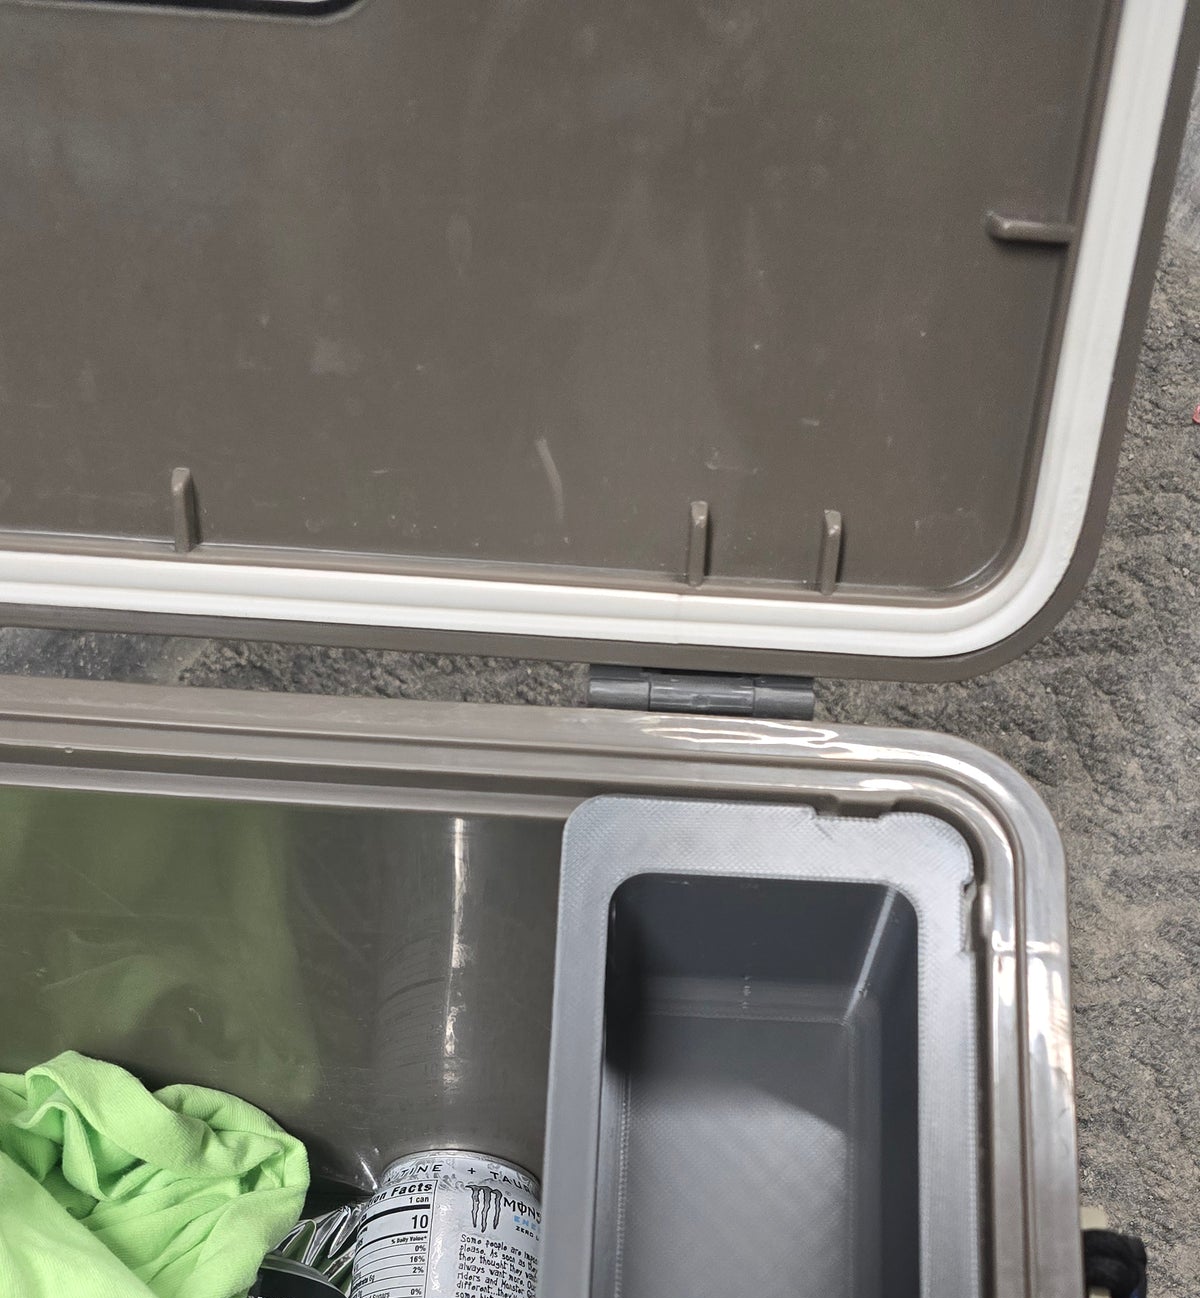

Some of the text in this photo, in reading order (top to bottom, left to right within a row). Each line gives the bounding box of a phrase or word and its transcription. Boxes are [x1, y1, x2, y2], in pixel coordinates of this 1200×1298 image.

[391, 1183, 432, 1197] Facts
[412, 1215, 428, 1229] 10
[460, 1244, 486, 1255] please.
[490, 1249, 498, 1258] As
[461, 1234, 521, 1256] Some people are
[459, 1250, 475, 1263] they
[480, 1256, 508, 1269] thought
[458, 1262, 485, 1274] always
[457, 1272, 524, 1294] riders and Monster
